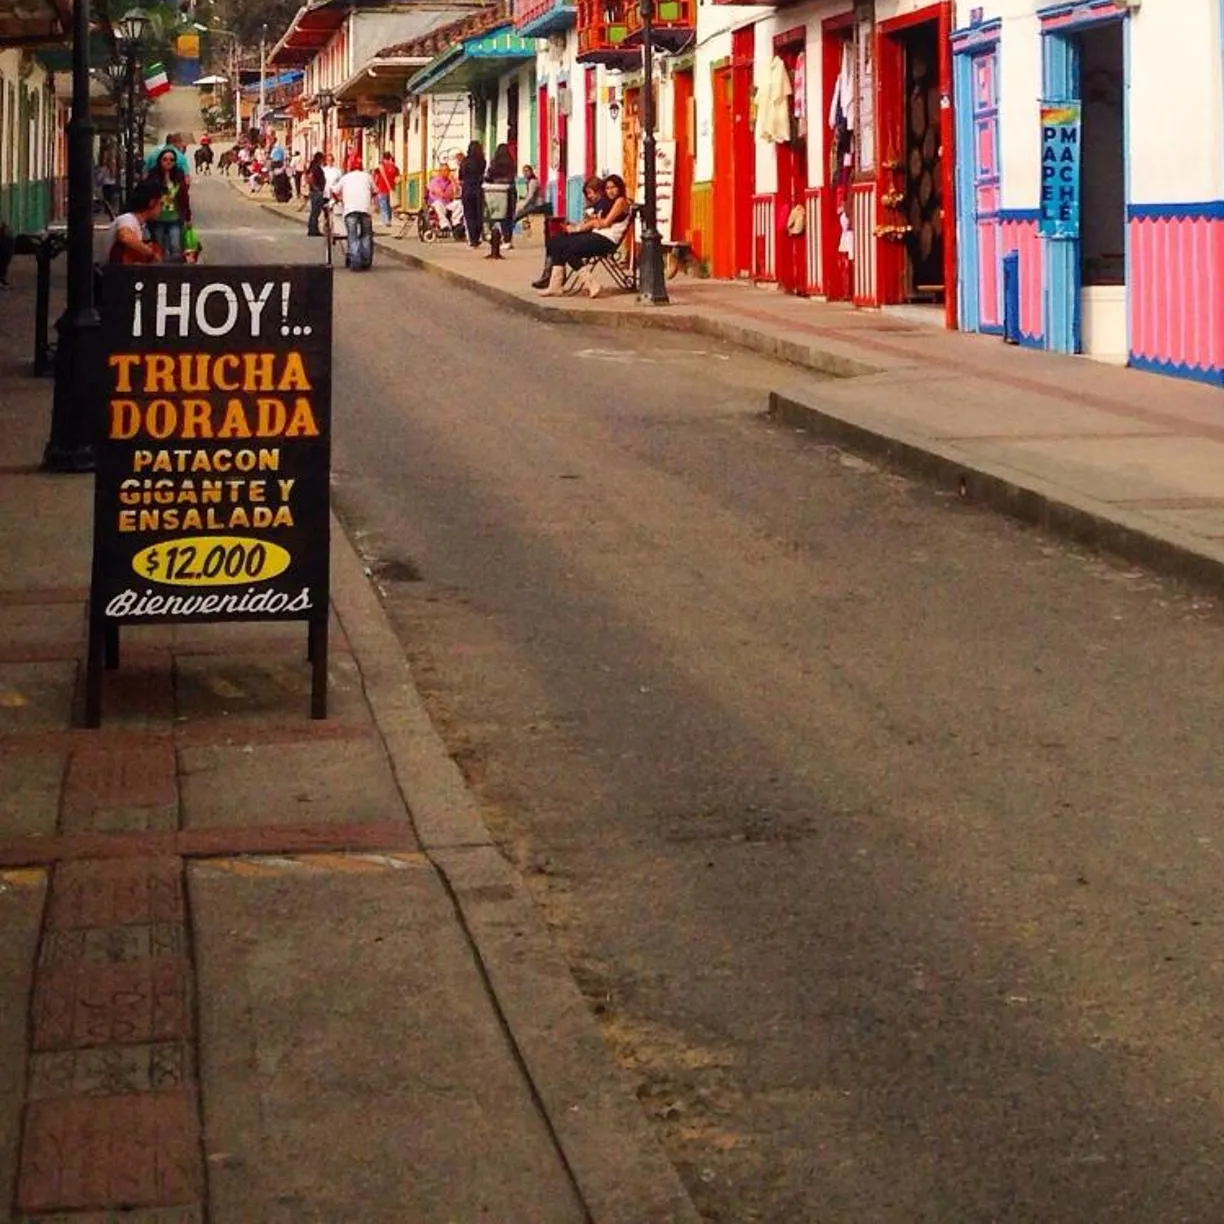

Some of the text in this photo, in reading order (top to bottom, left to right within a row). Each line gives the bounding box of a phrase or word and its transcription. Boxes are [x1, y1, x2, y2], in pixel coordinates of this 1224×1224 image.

[1042, 127, 1057, 220] PAPEL
[1059, 127, 1077, 221] MACHÉ
[108, 352, 311, 393] TRUCHA
[109, 398, 320, 440] DORADA
[133, 448, 279, 473] PATACON
[119, 479, 294, 504] GIGANTE Y
[118, 506, 294, 533] ENSALADA
[105, 587, 314, 617] Bienvenidos
